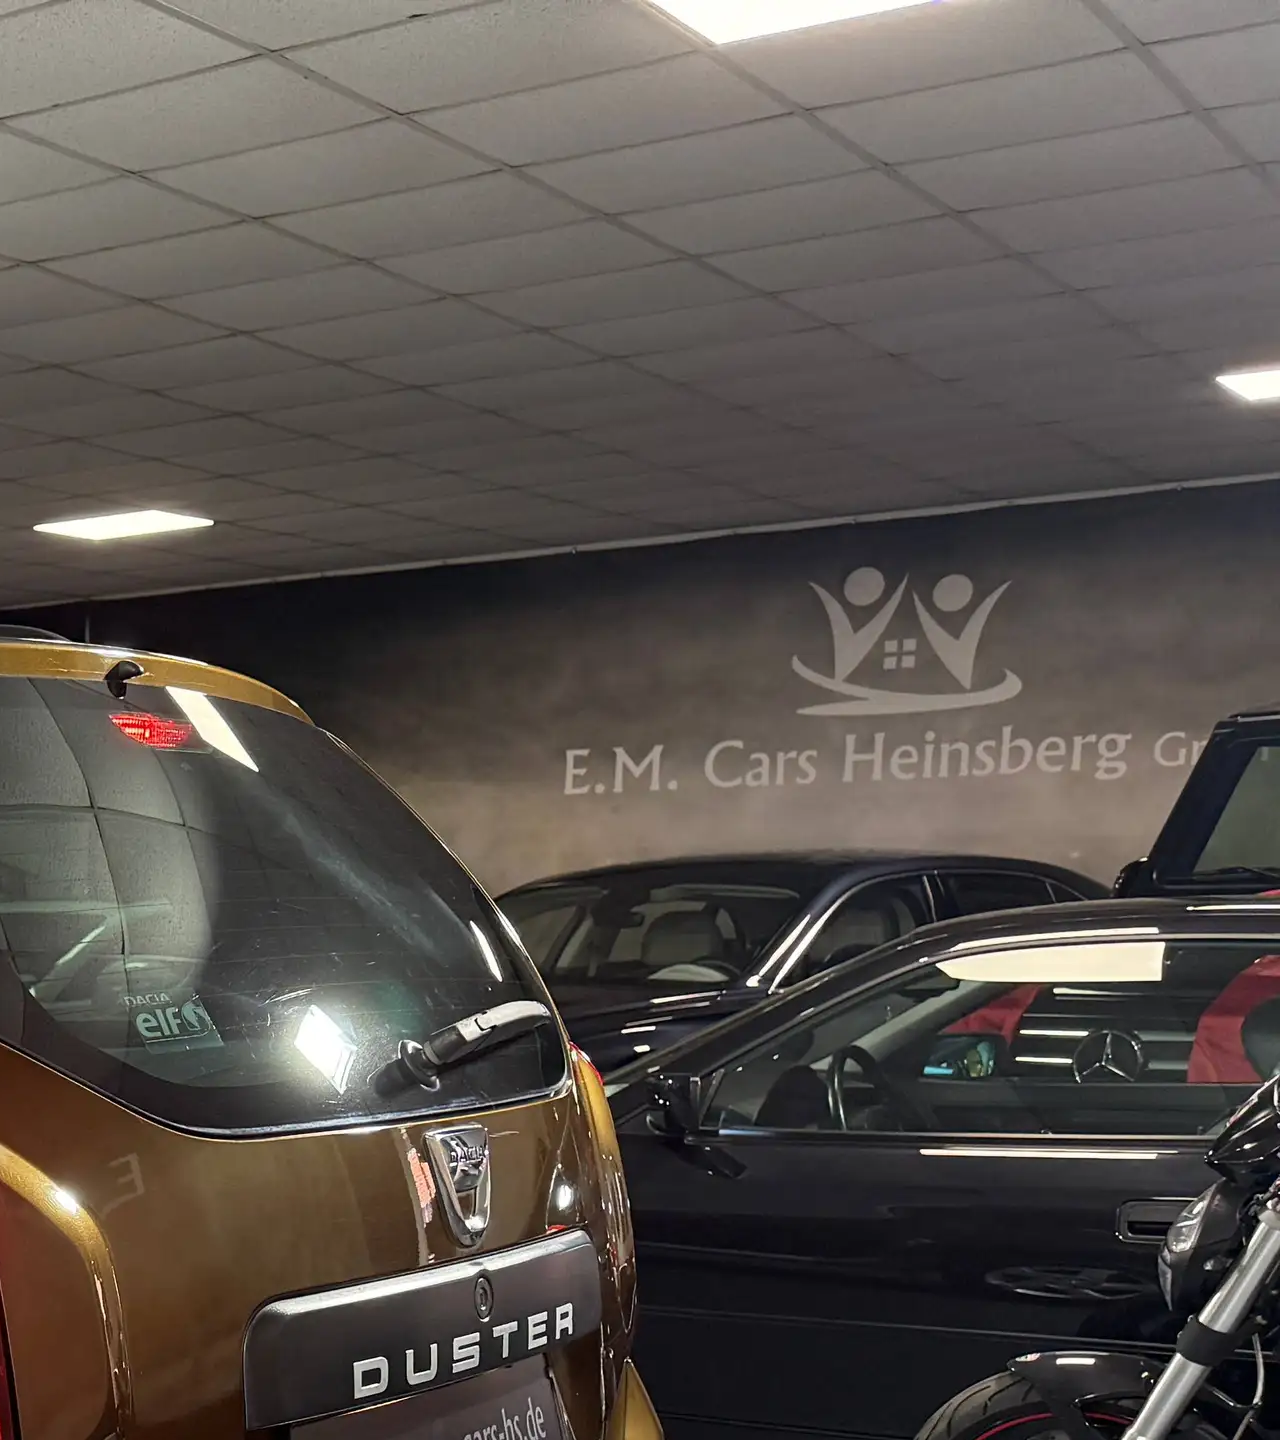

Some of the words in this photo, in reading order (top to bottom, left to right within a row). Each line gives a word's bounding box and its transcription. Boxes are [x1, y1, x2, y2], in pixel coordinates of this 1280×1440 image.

[564, 743, 678, 796] E.M.
[703, 739, 818, 790] Cars
[841, 725, 1133, 781] Heinsberg
[124, 992, 171, 1007] DACIA
[135, 1006, 182, 1038] elf
[450, 1145, 486, 1162] DACIA
[353, 1301, 574, 1400] DUSTER
